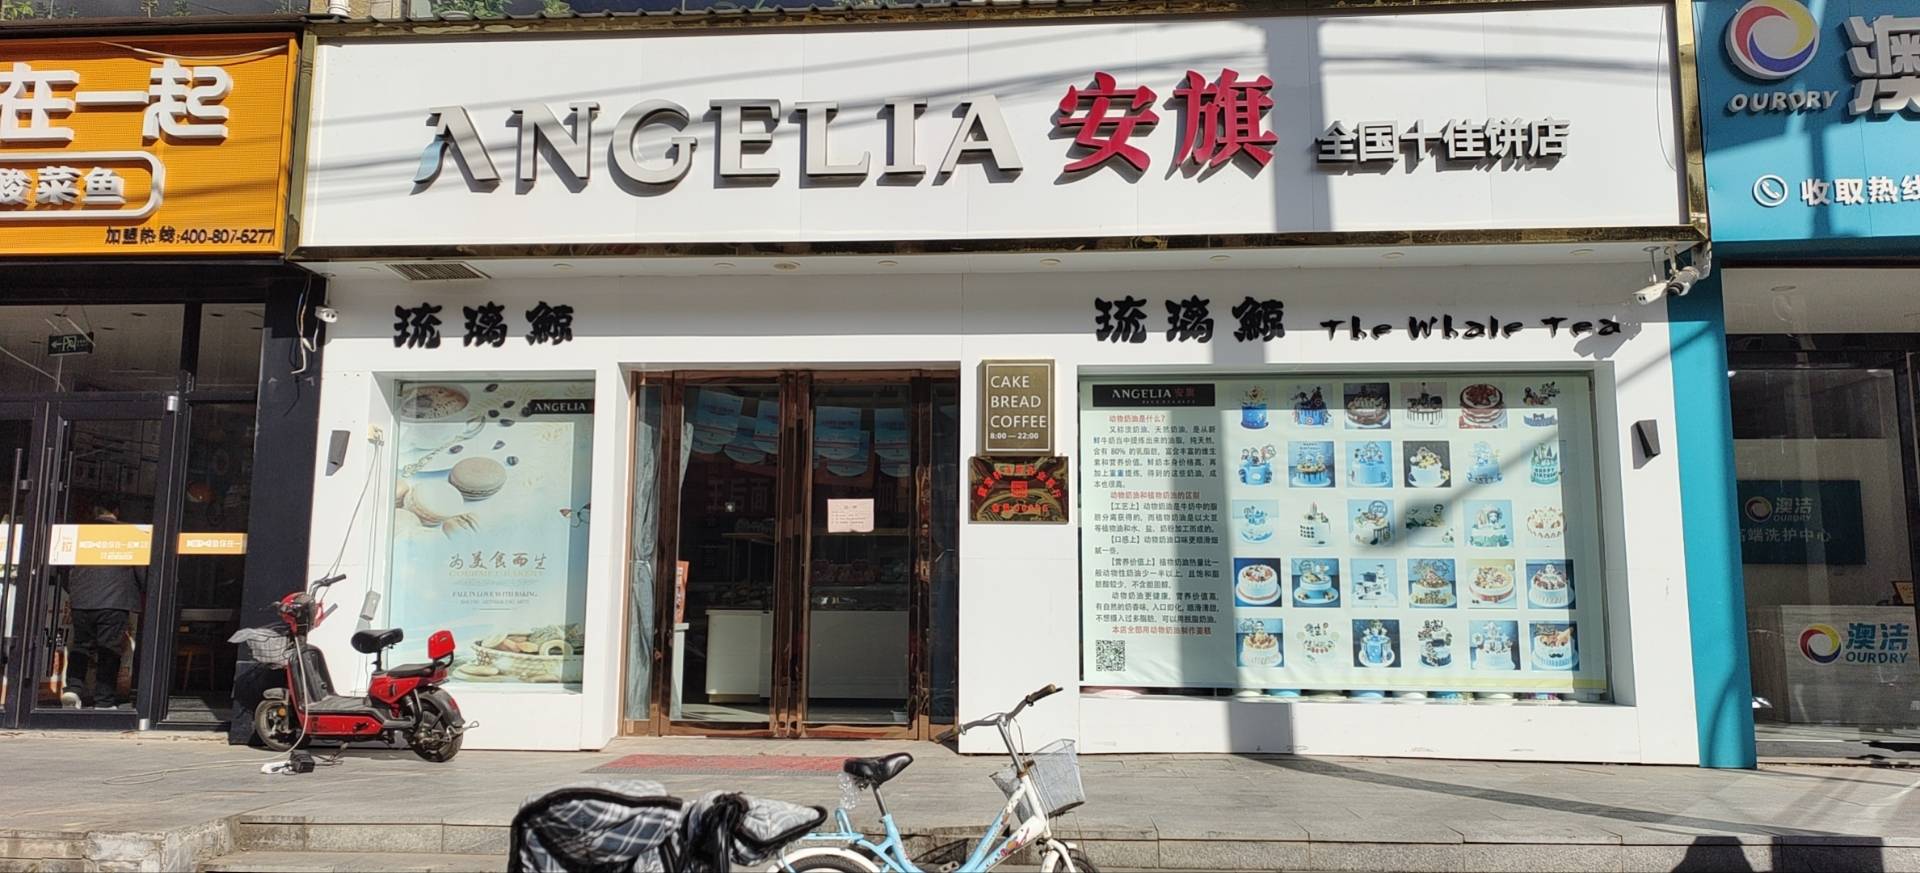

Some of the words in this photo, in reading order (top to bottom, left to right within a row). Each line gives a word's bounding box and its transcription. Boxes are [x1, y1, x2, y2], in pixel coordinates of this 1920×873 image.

[1729, 90, 1839, 112] OURDRY
[1057, 67, 1278, 172] 安旗
[413, 95, 1022, 187] ANGELIA
[1316, 117, 1571, 163] 全国十佳饼店
[1320, 315, 1393, 341] The
[1408, 313, 1523, 341] Whale
[1540, 315, 1621, 338] Tea
[990, 375, 1030, 389] CAKE
[990, 395, 1041, 408] BREAD
[1112, 388, 1172, 399] ANGELIA
[534, 402, 587, 412] ANGELIA
[990, 415, 1047, 428] COFFEE
[449, 550, 548, 570] 为美食而生
[1846, 622, 1910, 651] 澳洁
[1846, 651, 1909, 665] OURDRY
